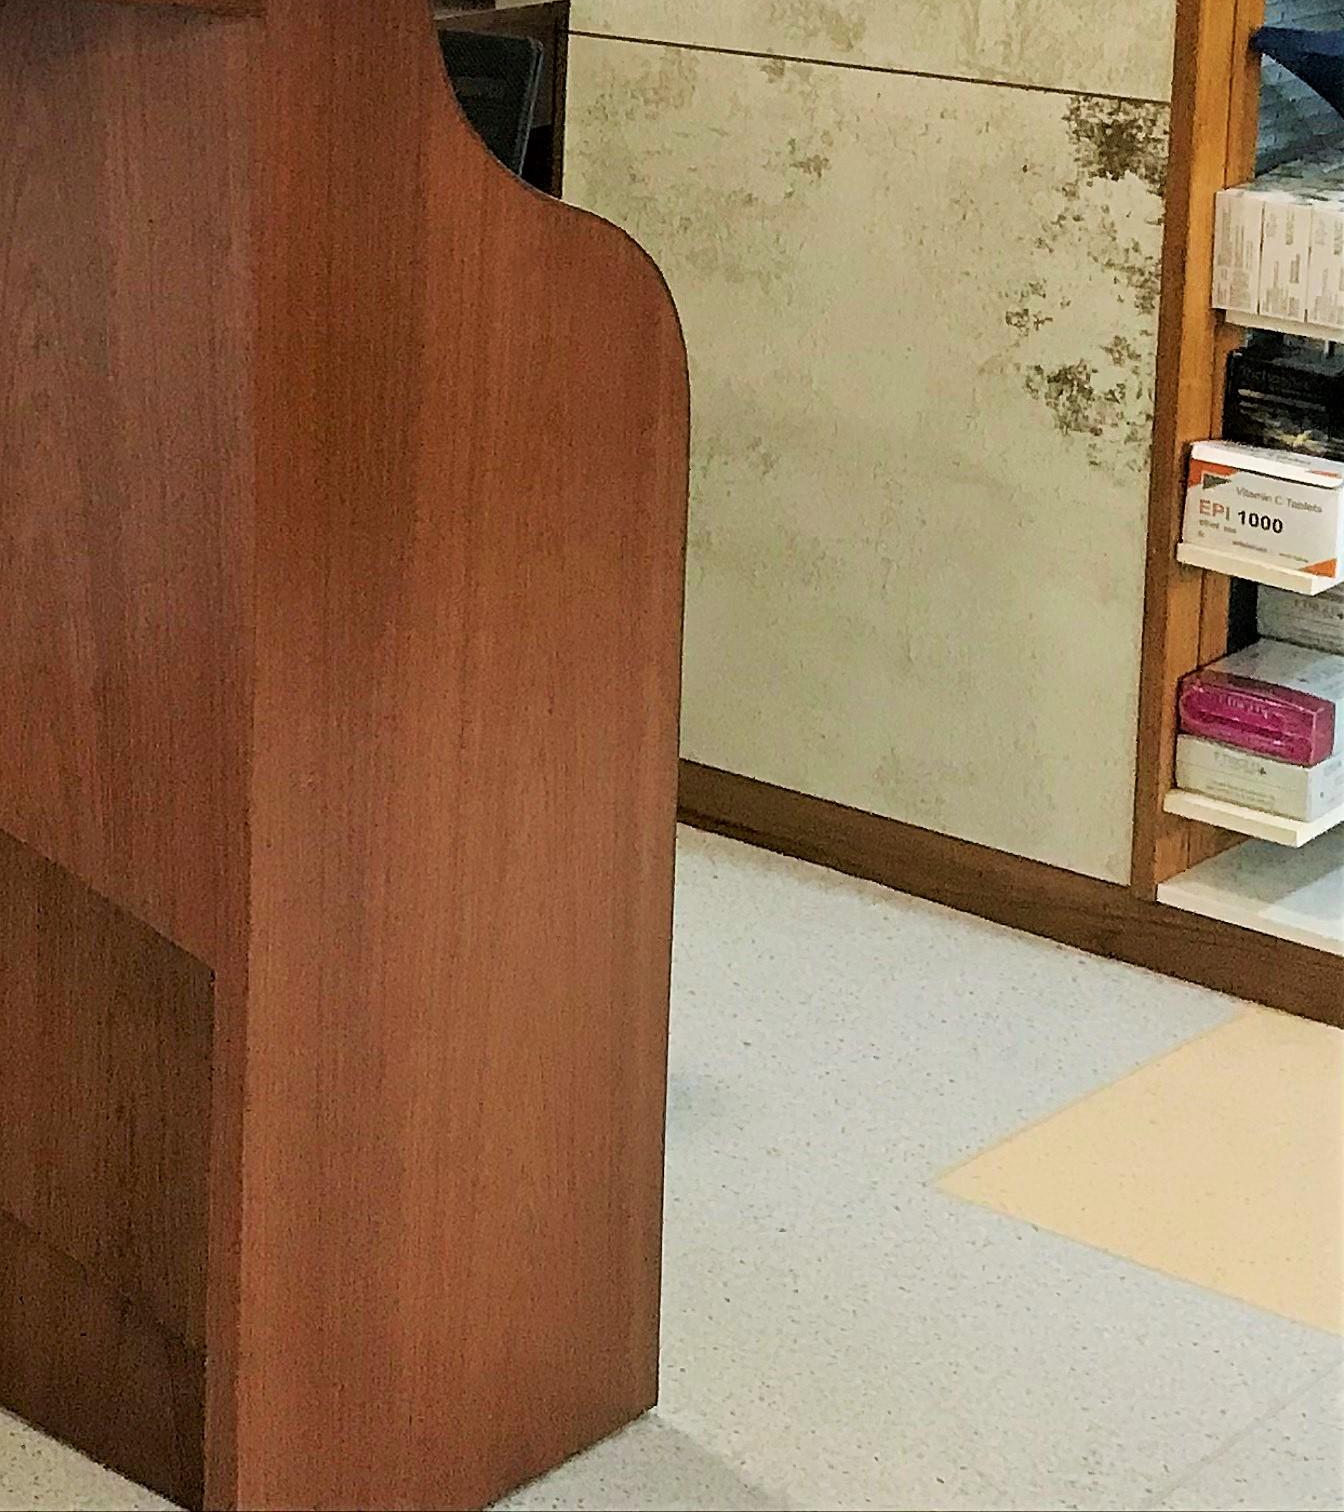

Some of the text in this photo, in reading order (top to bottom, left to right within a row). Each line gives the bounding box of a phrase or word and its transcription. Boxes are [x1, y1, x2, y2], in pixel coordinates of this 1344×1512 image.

[1236, 486, 1323, 514] Vitamin C Tablets
[1199, 499, 1284, 534] EPI 1000
